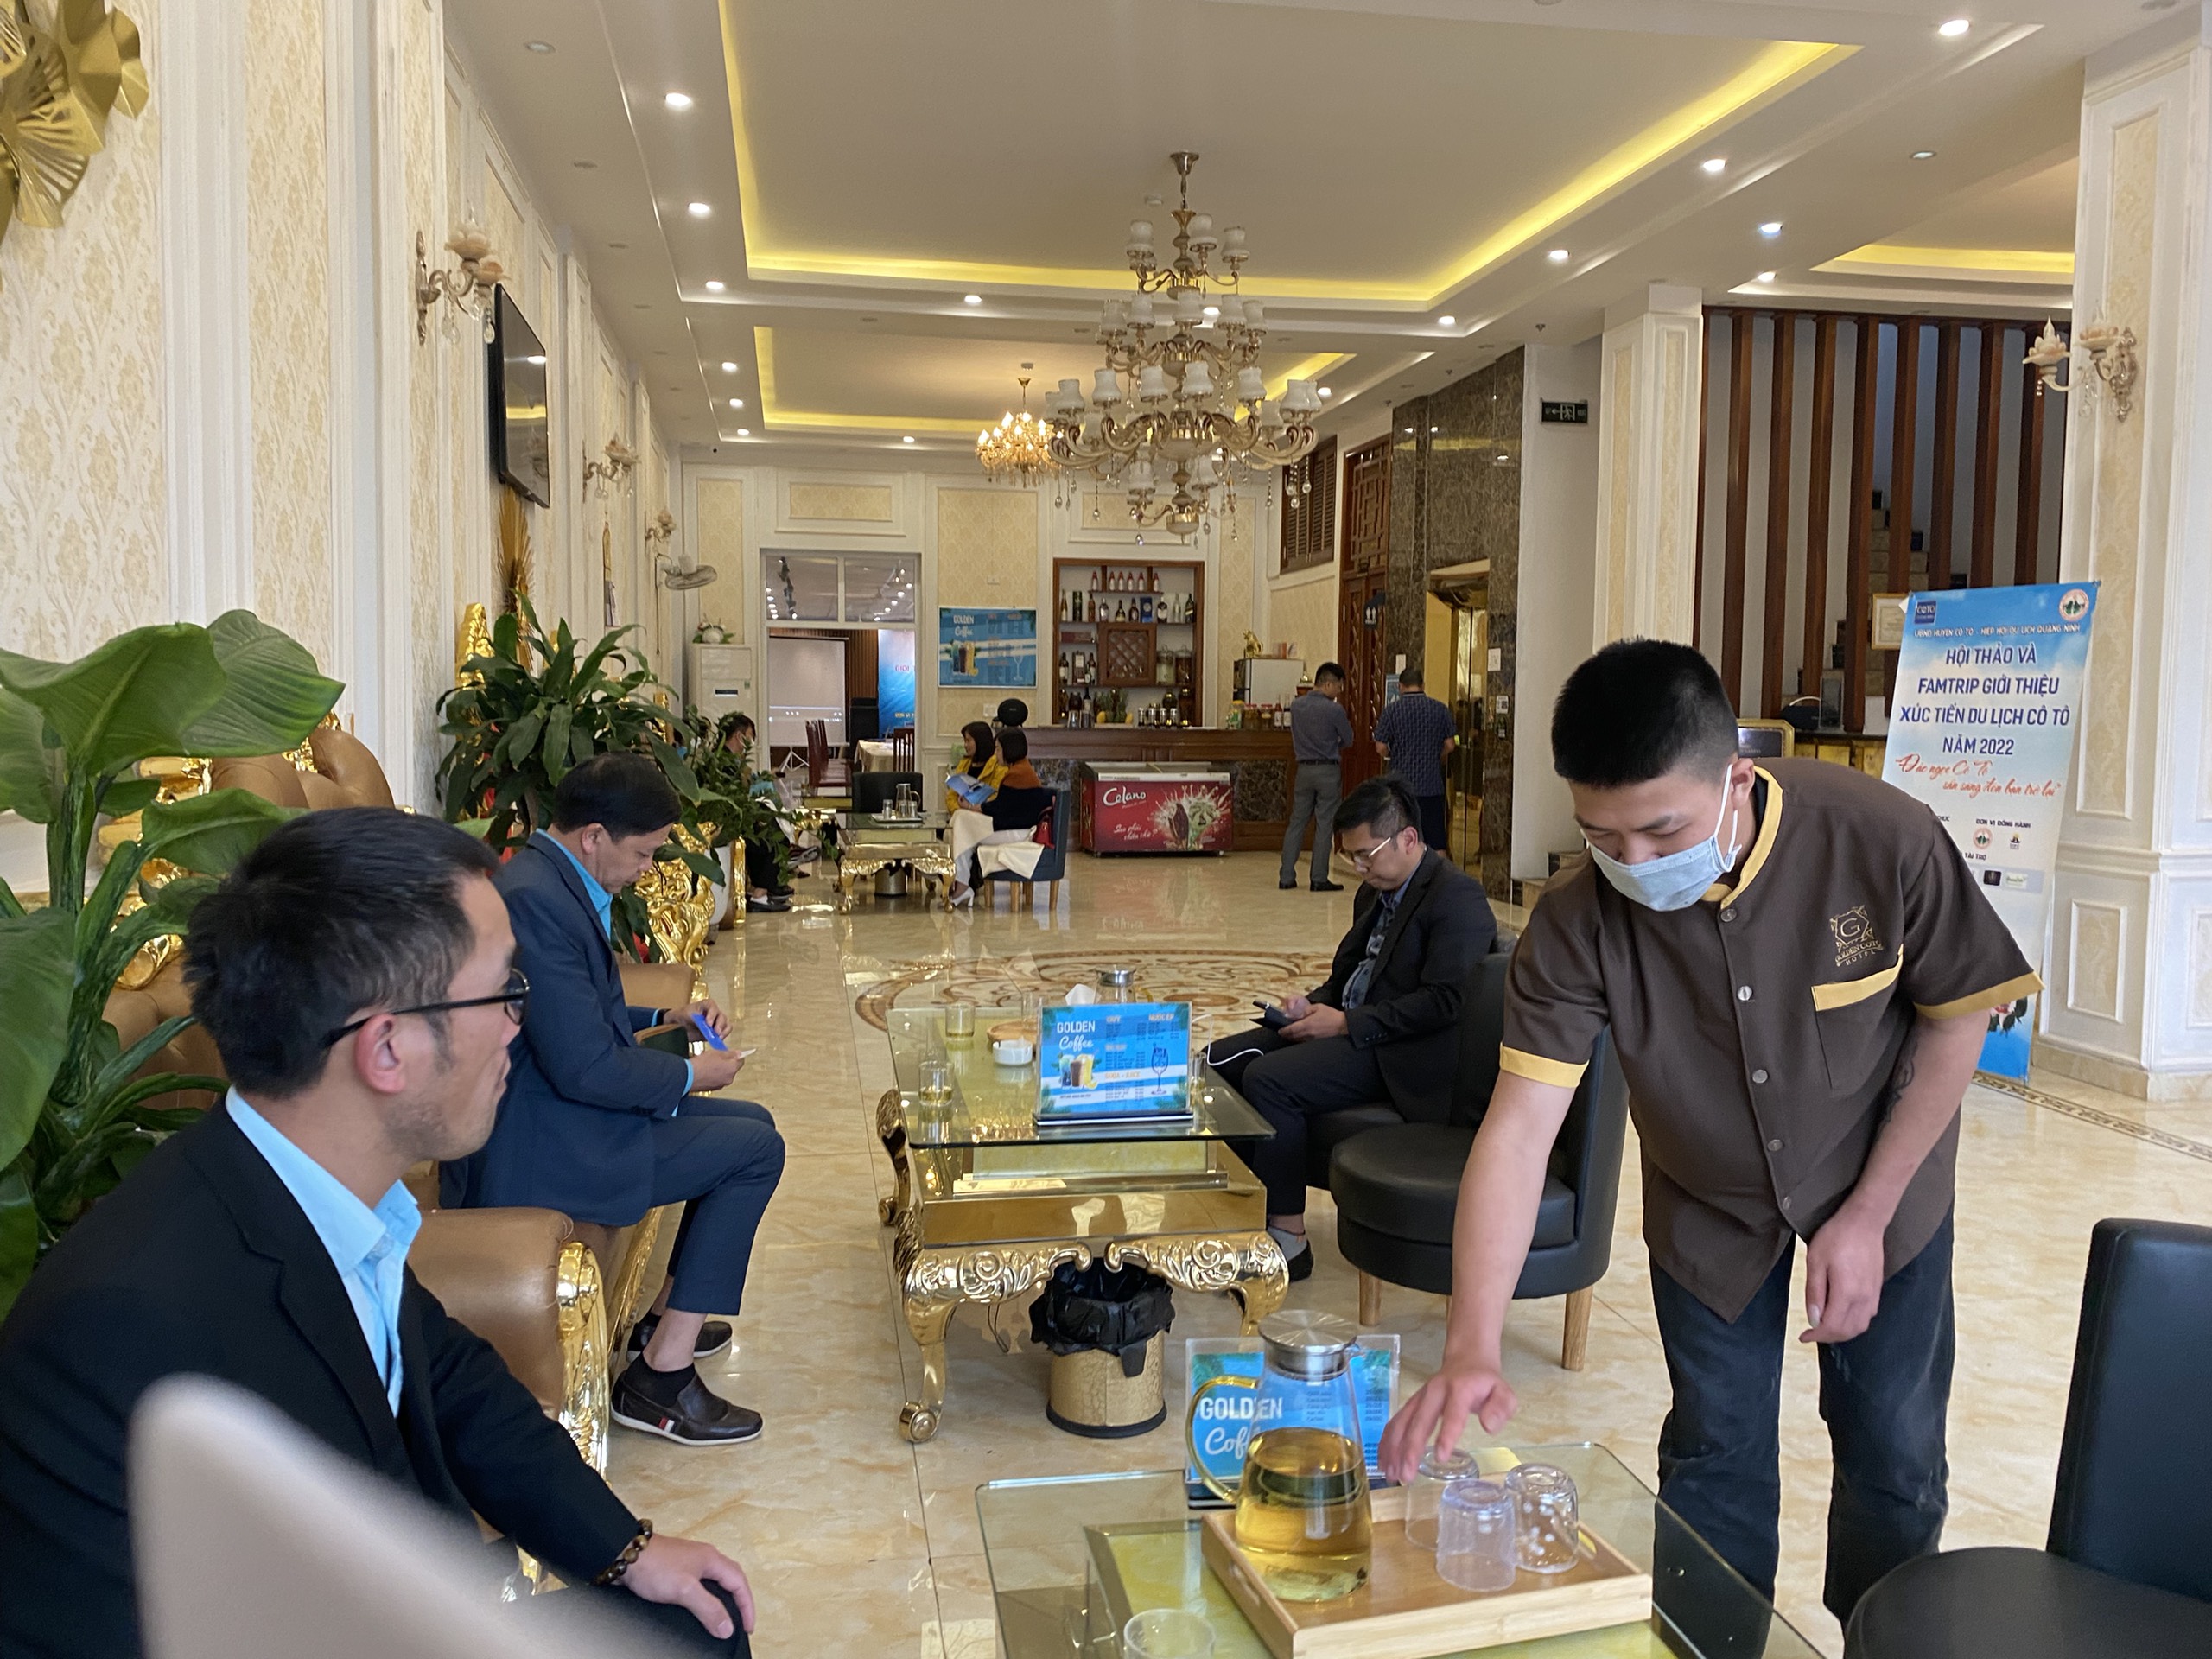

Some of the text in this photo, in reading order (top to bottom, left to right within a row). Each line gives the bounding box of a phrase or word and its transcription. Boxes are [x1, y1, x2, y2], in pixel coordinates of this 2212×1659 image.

[1945, 642, 2037, 668] HỘI THẢO VÀ
[1917, 674, 2060, 698] FAMTRIP GIỚI THIỆU
[1899, 702, 2070, 728] XÚC TIẾN DU LỊCH CÔ TÔ
[1942, 734, 2015, 756] NĂM 2022
[1103, 786, 1147, 806] Celano
[1840, 918, 1860, 938] G
[1057, 1020, 1096, 1033] GOLDEN
[1058, 1034, 1094, 1052] Coffee
[1199, 1397, 1284, 1421] GOLDEN
